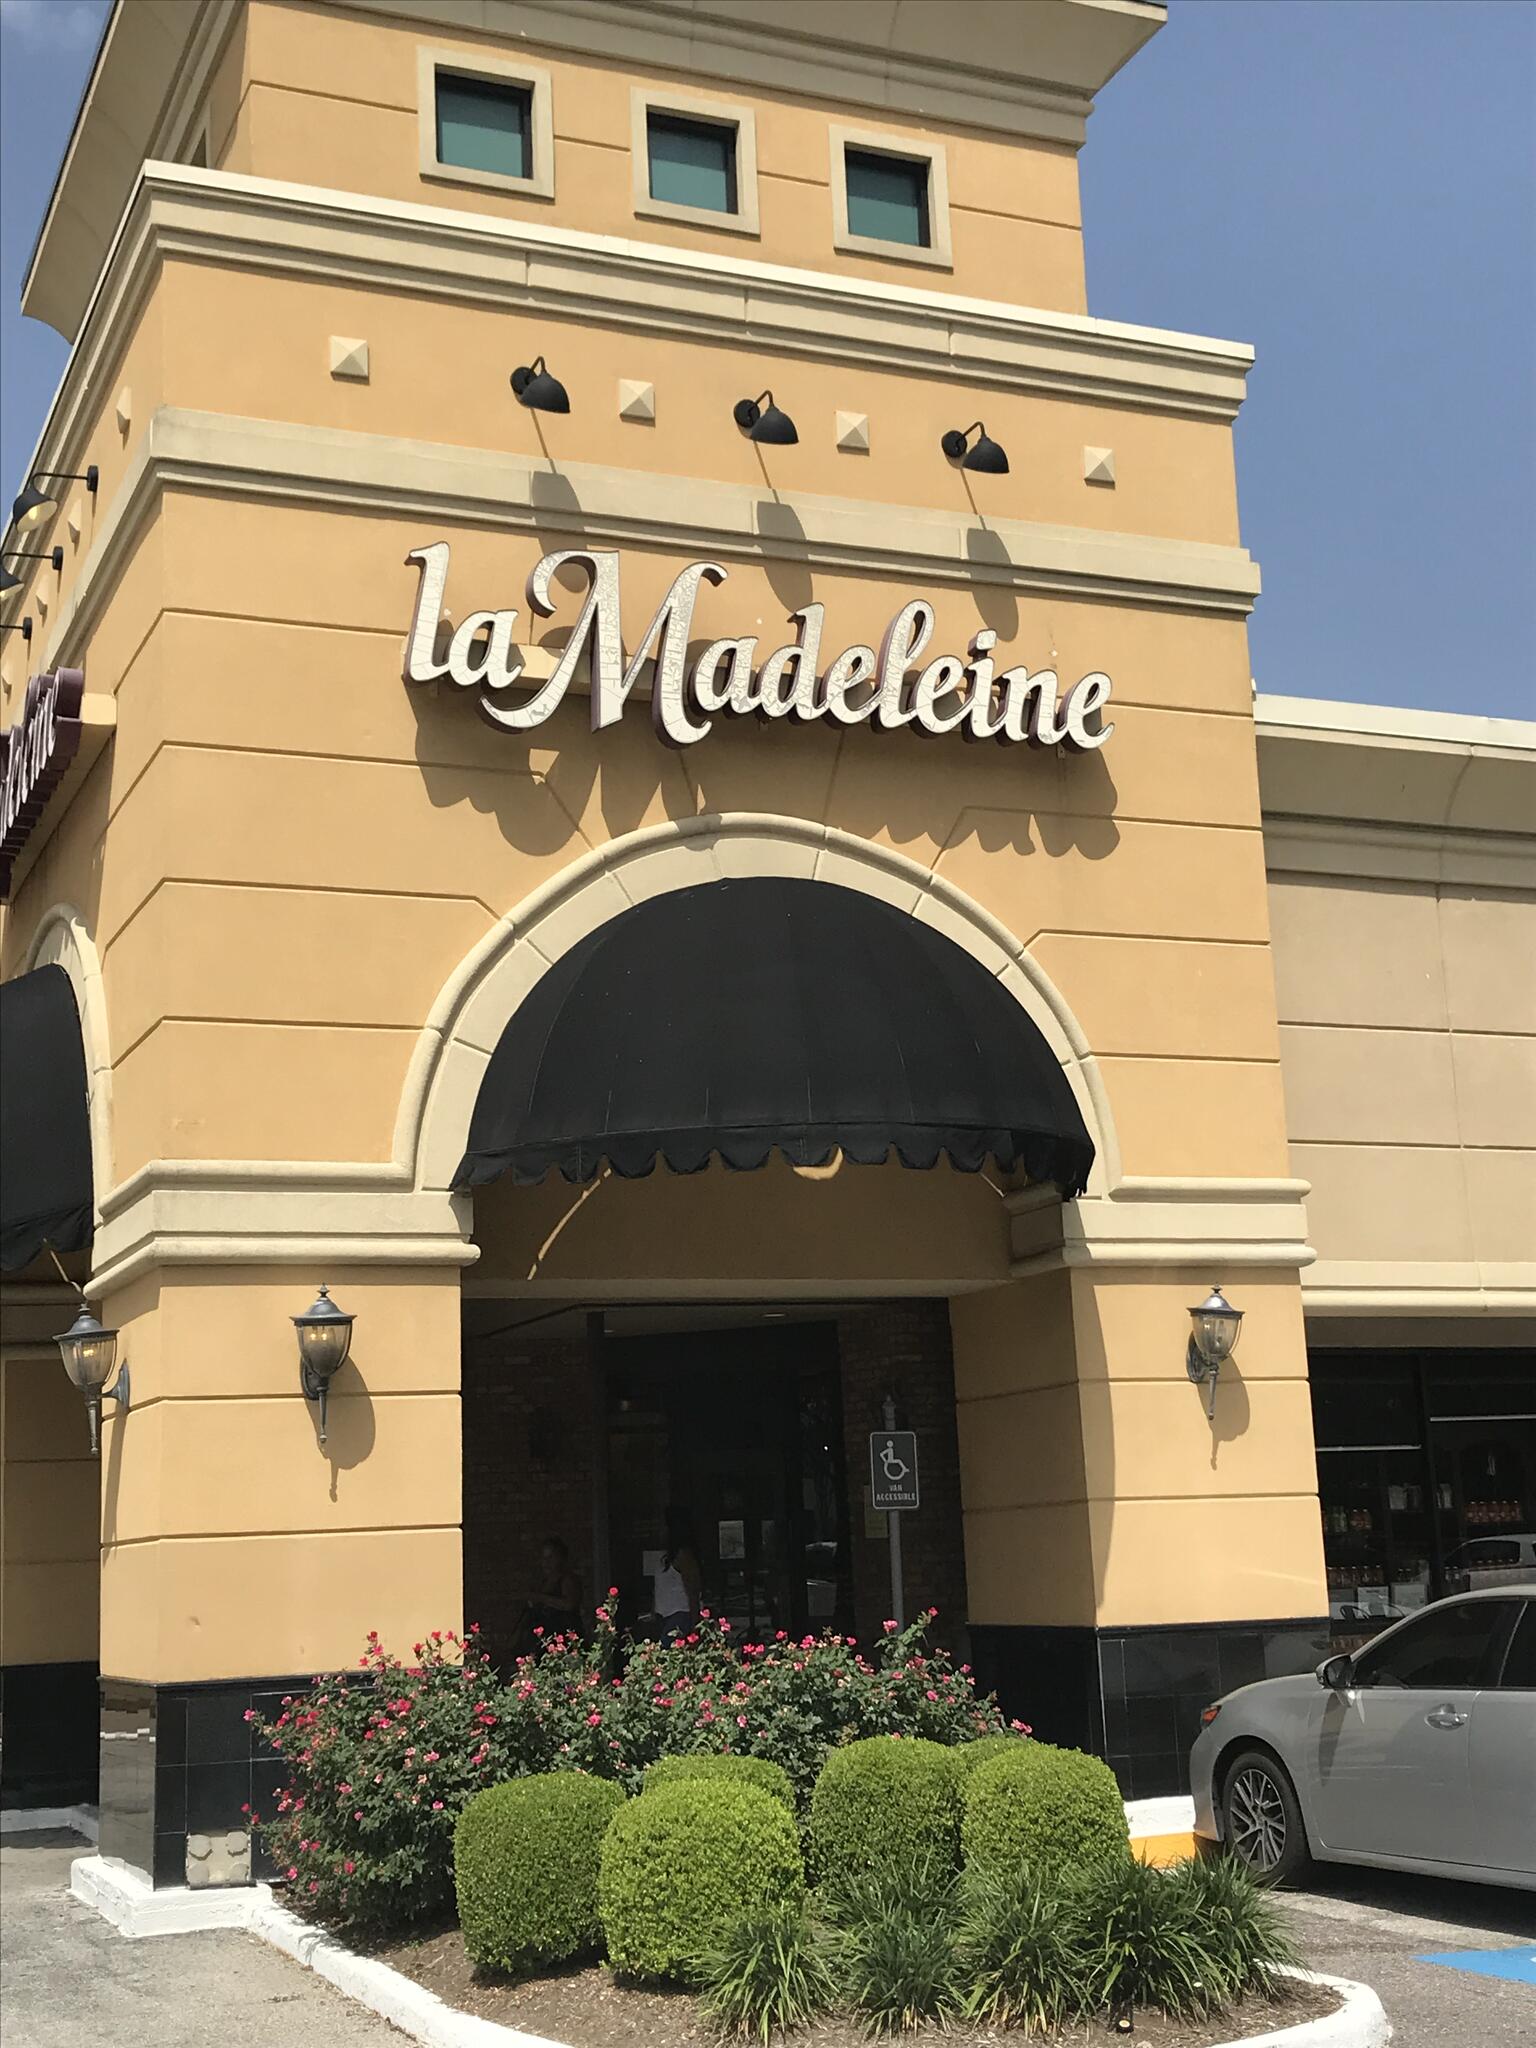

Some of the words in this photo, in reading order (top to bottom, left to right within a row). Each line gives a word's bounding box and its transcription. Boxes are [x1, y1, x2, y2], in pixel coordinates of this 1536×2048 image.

[403, 541, 522, 688] la
[478, 550, 1115, 750] Madeleine
[889, 1484, 903, 1492] VAN
[876, 1493, 916, 1501] ACCESSIBLE
